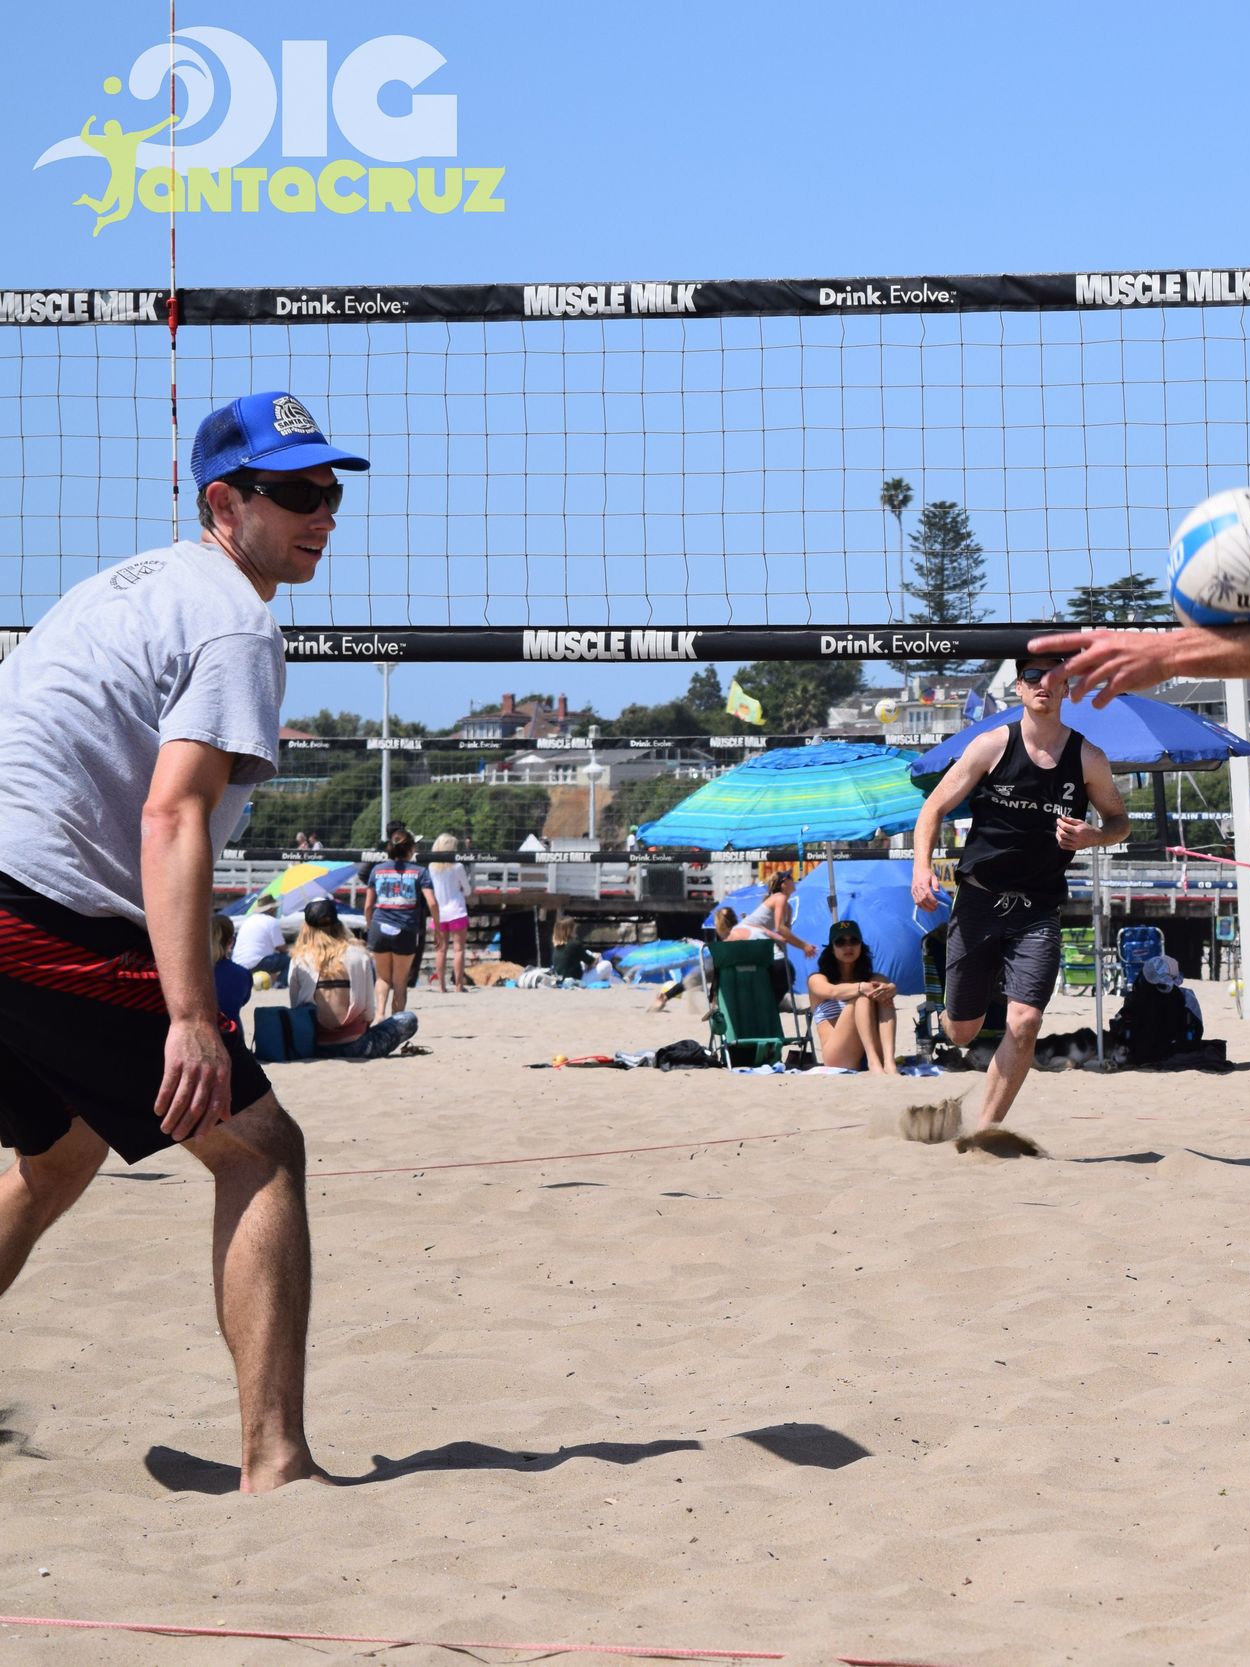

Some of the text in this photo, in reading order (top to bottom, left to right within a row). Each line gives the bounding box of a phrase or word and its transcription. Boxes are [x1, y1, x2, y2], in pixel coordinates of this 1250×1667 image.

[819, 287, 887, 306] Drink.
[1076, 273, 1181, 305] MUSCLE
[0, 291, 90, 322] MUSCLE
[276, 295, 341, 315] Drink.
[523, 285, 626, 316] MUSCLE
[523, 630, 626, 660] MUSCLE
[821, 634, 889, 654] Drink.
[537, 738, 571, 749] MUSCLE
[710, 737, 744, 748] MUSCLE
[885, 735, 918, 745] MUSCLE
[1062, 782, 1075, 800] 2
[991, 796, 1073, 817] SANTA CRUZ
[282, 852, 302, 860] Drink.
[535, 852, 569, 863] MUSCLE
[711, 852, 745, 861] MUSCLE
[889, 849, 914, 859] MUSC
